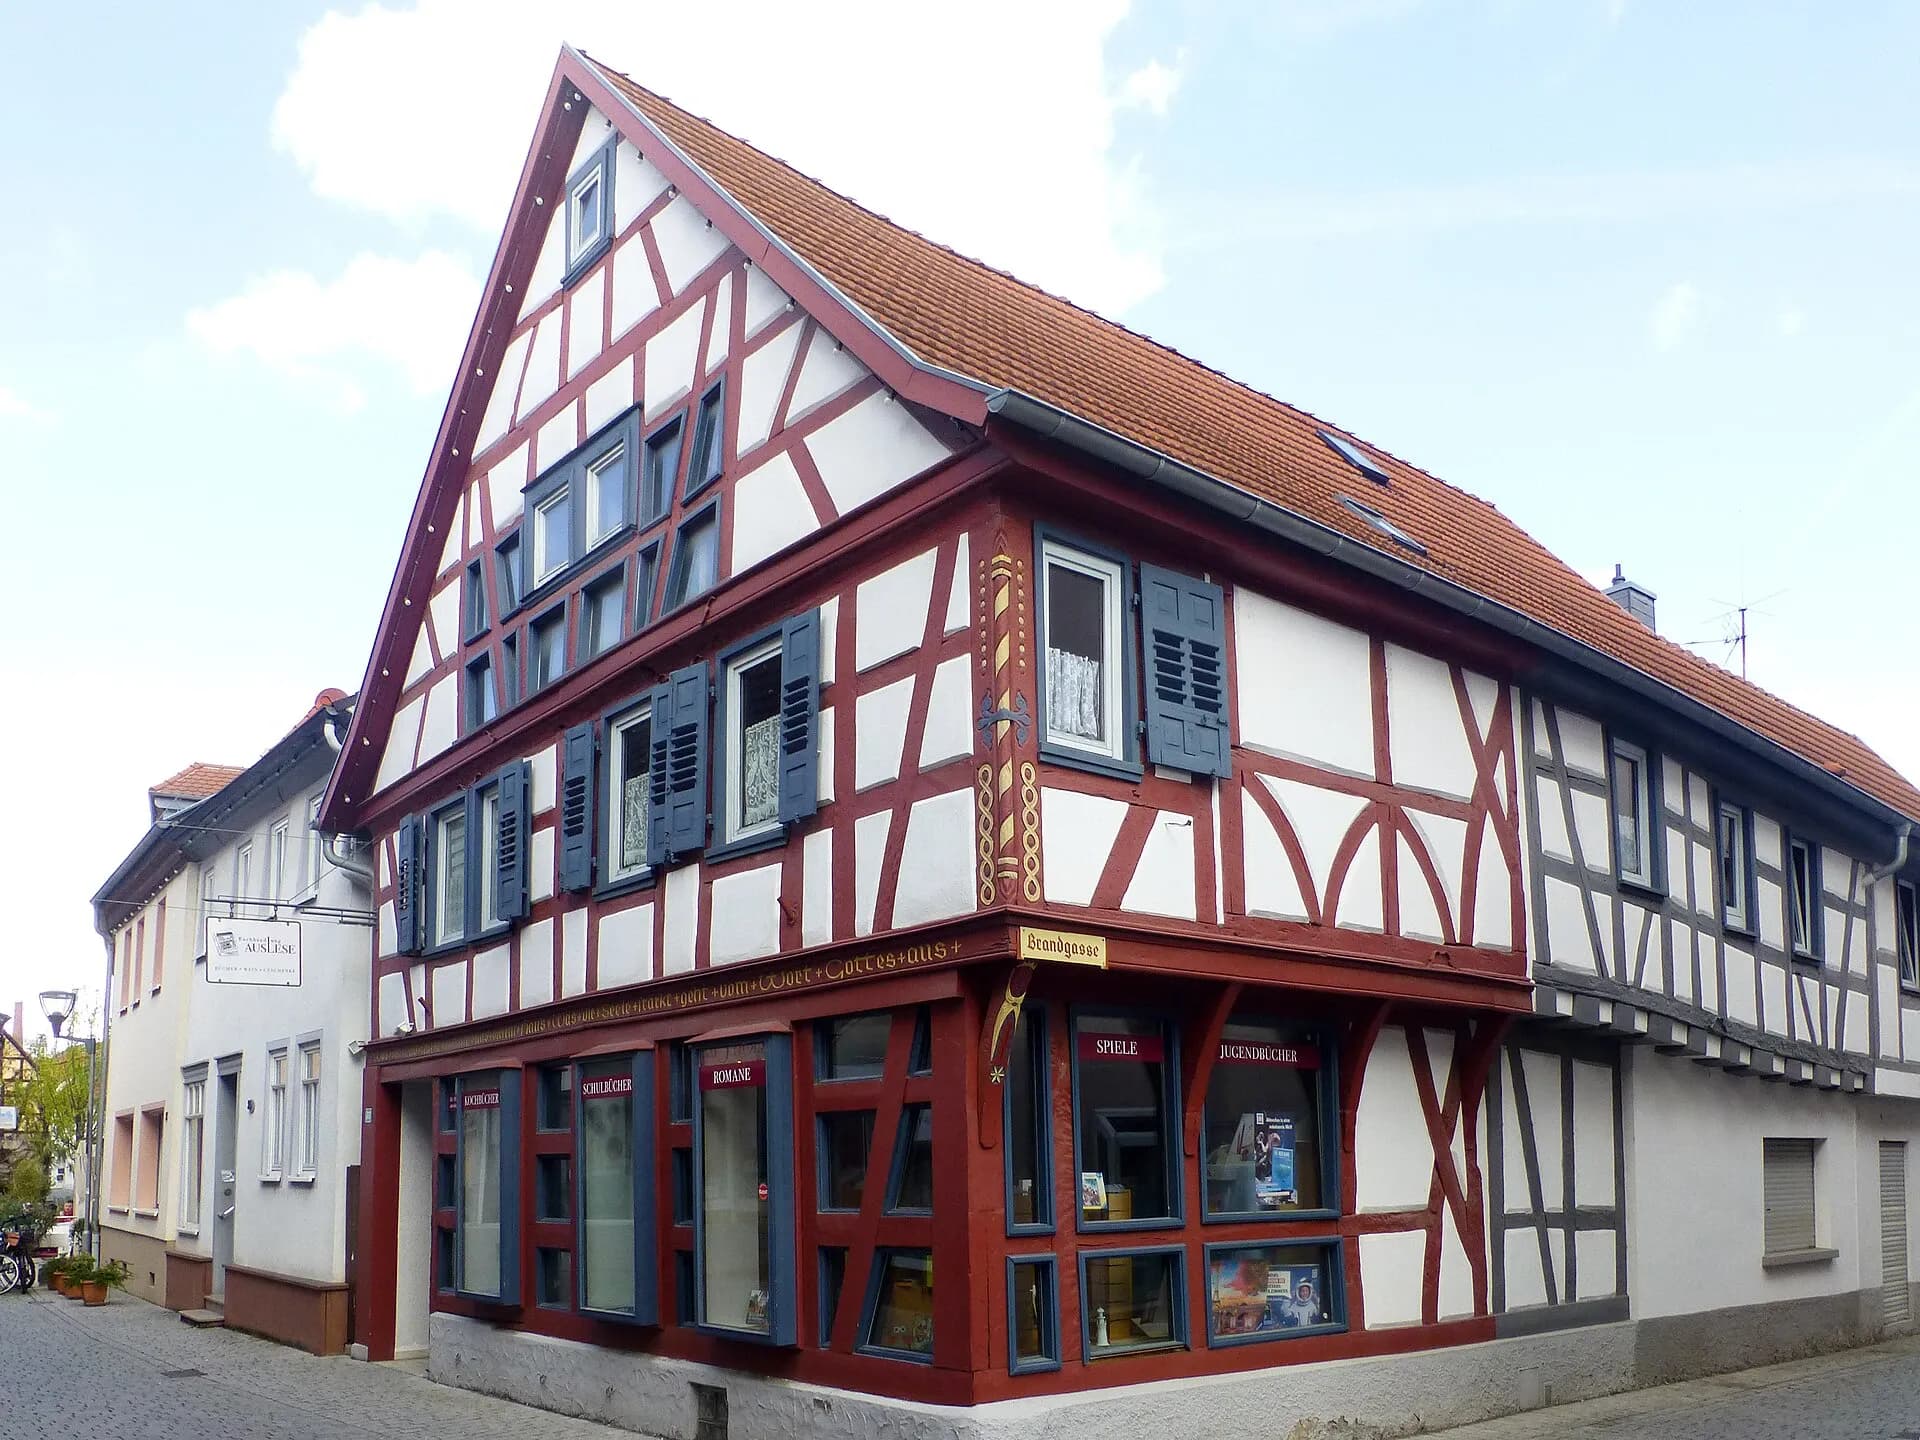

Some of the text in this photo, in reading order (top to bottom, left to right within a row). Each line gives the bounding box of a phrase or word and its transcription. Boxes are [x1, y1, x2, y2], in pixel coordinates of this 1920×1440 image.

[245, 937, 296, 954] AUSLESE
[1027, 933, 1099, 959] Brandgasse
[720, 980, 749, 998] vom
[760, 965, 812, 991] Wort
[825, 953, 896, 979] Gottes
[907, 942, 947, 964] aus
[1096, 1040, 1138, 1055] SPIELE
[1220, 1044, 1298, 1062] JUGENDBÜCHER
[713, 1067, 751, 1085] ROMANE
[583, 1078, 632, 1095] SCHULBÜCHER
[464, 1092, 499, 1107] KOCHBÜCHER
